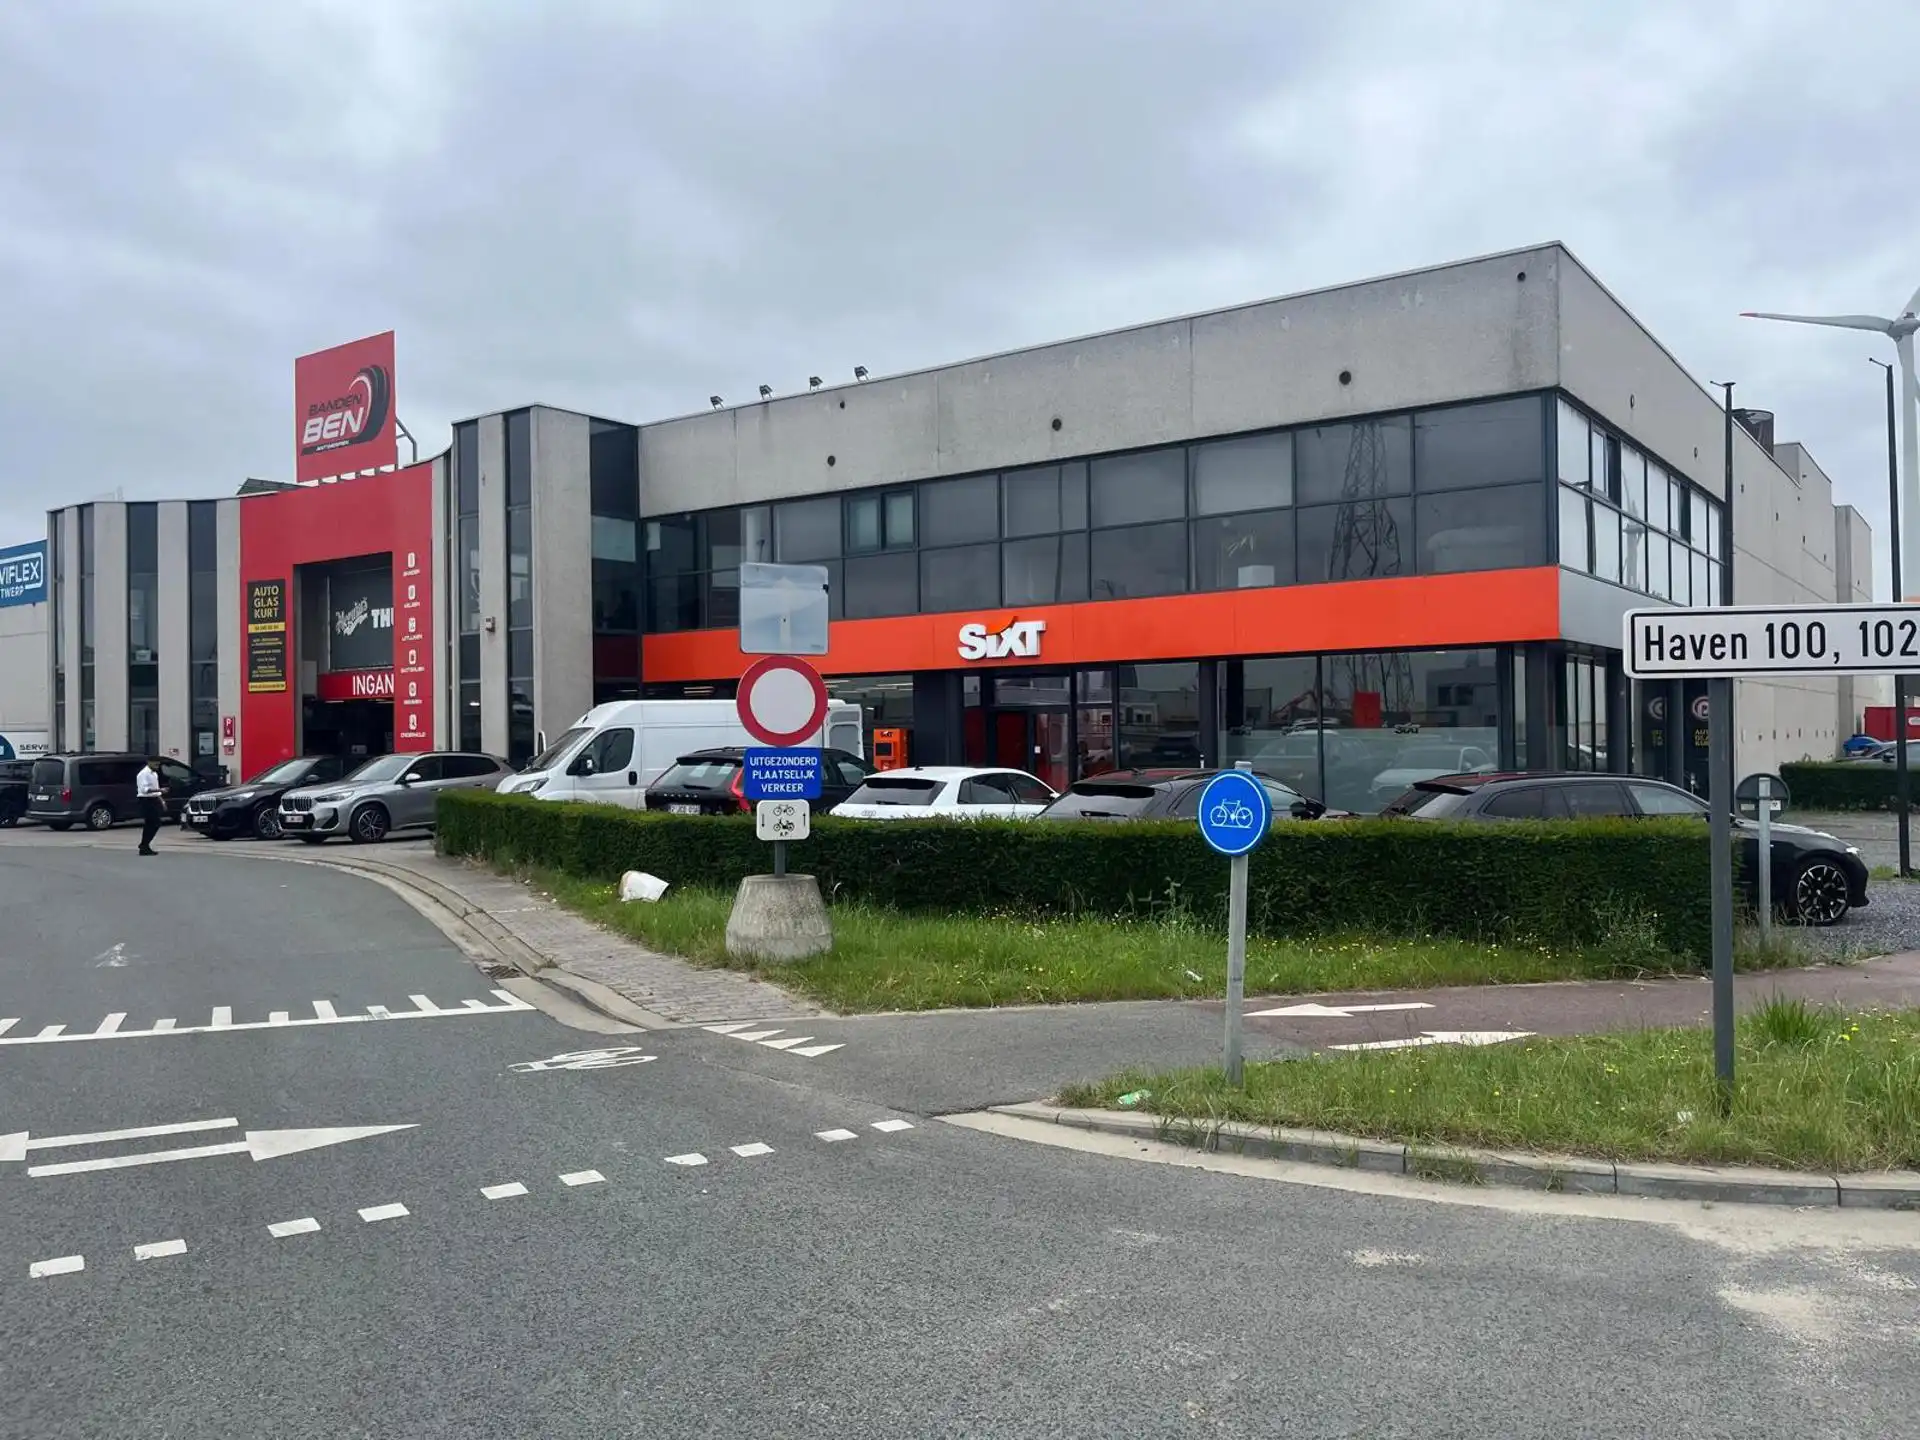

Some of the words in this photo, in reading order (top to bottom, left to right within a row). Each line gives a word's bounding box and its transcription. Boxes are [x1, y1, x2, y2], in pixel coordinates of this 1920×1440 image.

[309, 394, 362, 416] BANDEN
[302, 407, 364, 444] BEN
[253, 585, 279, 597] AUTO
[253, 597, 279, 608] GLAS
[254, 608, 278, 618] KURT
[1644, 625, 1747, 661] Haven
[1765, 621, 1840, 664] 100,
[1859, 619, 1919, 656] 102
[352, 674, 394, 695] INGAN
[749, 756, 818, 767] UITGEZONDERD
[752, 769, 815, 780] PLAATSELIJK
[761, 782, 804, 793] VERKEER
